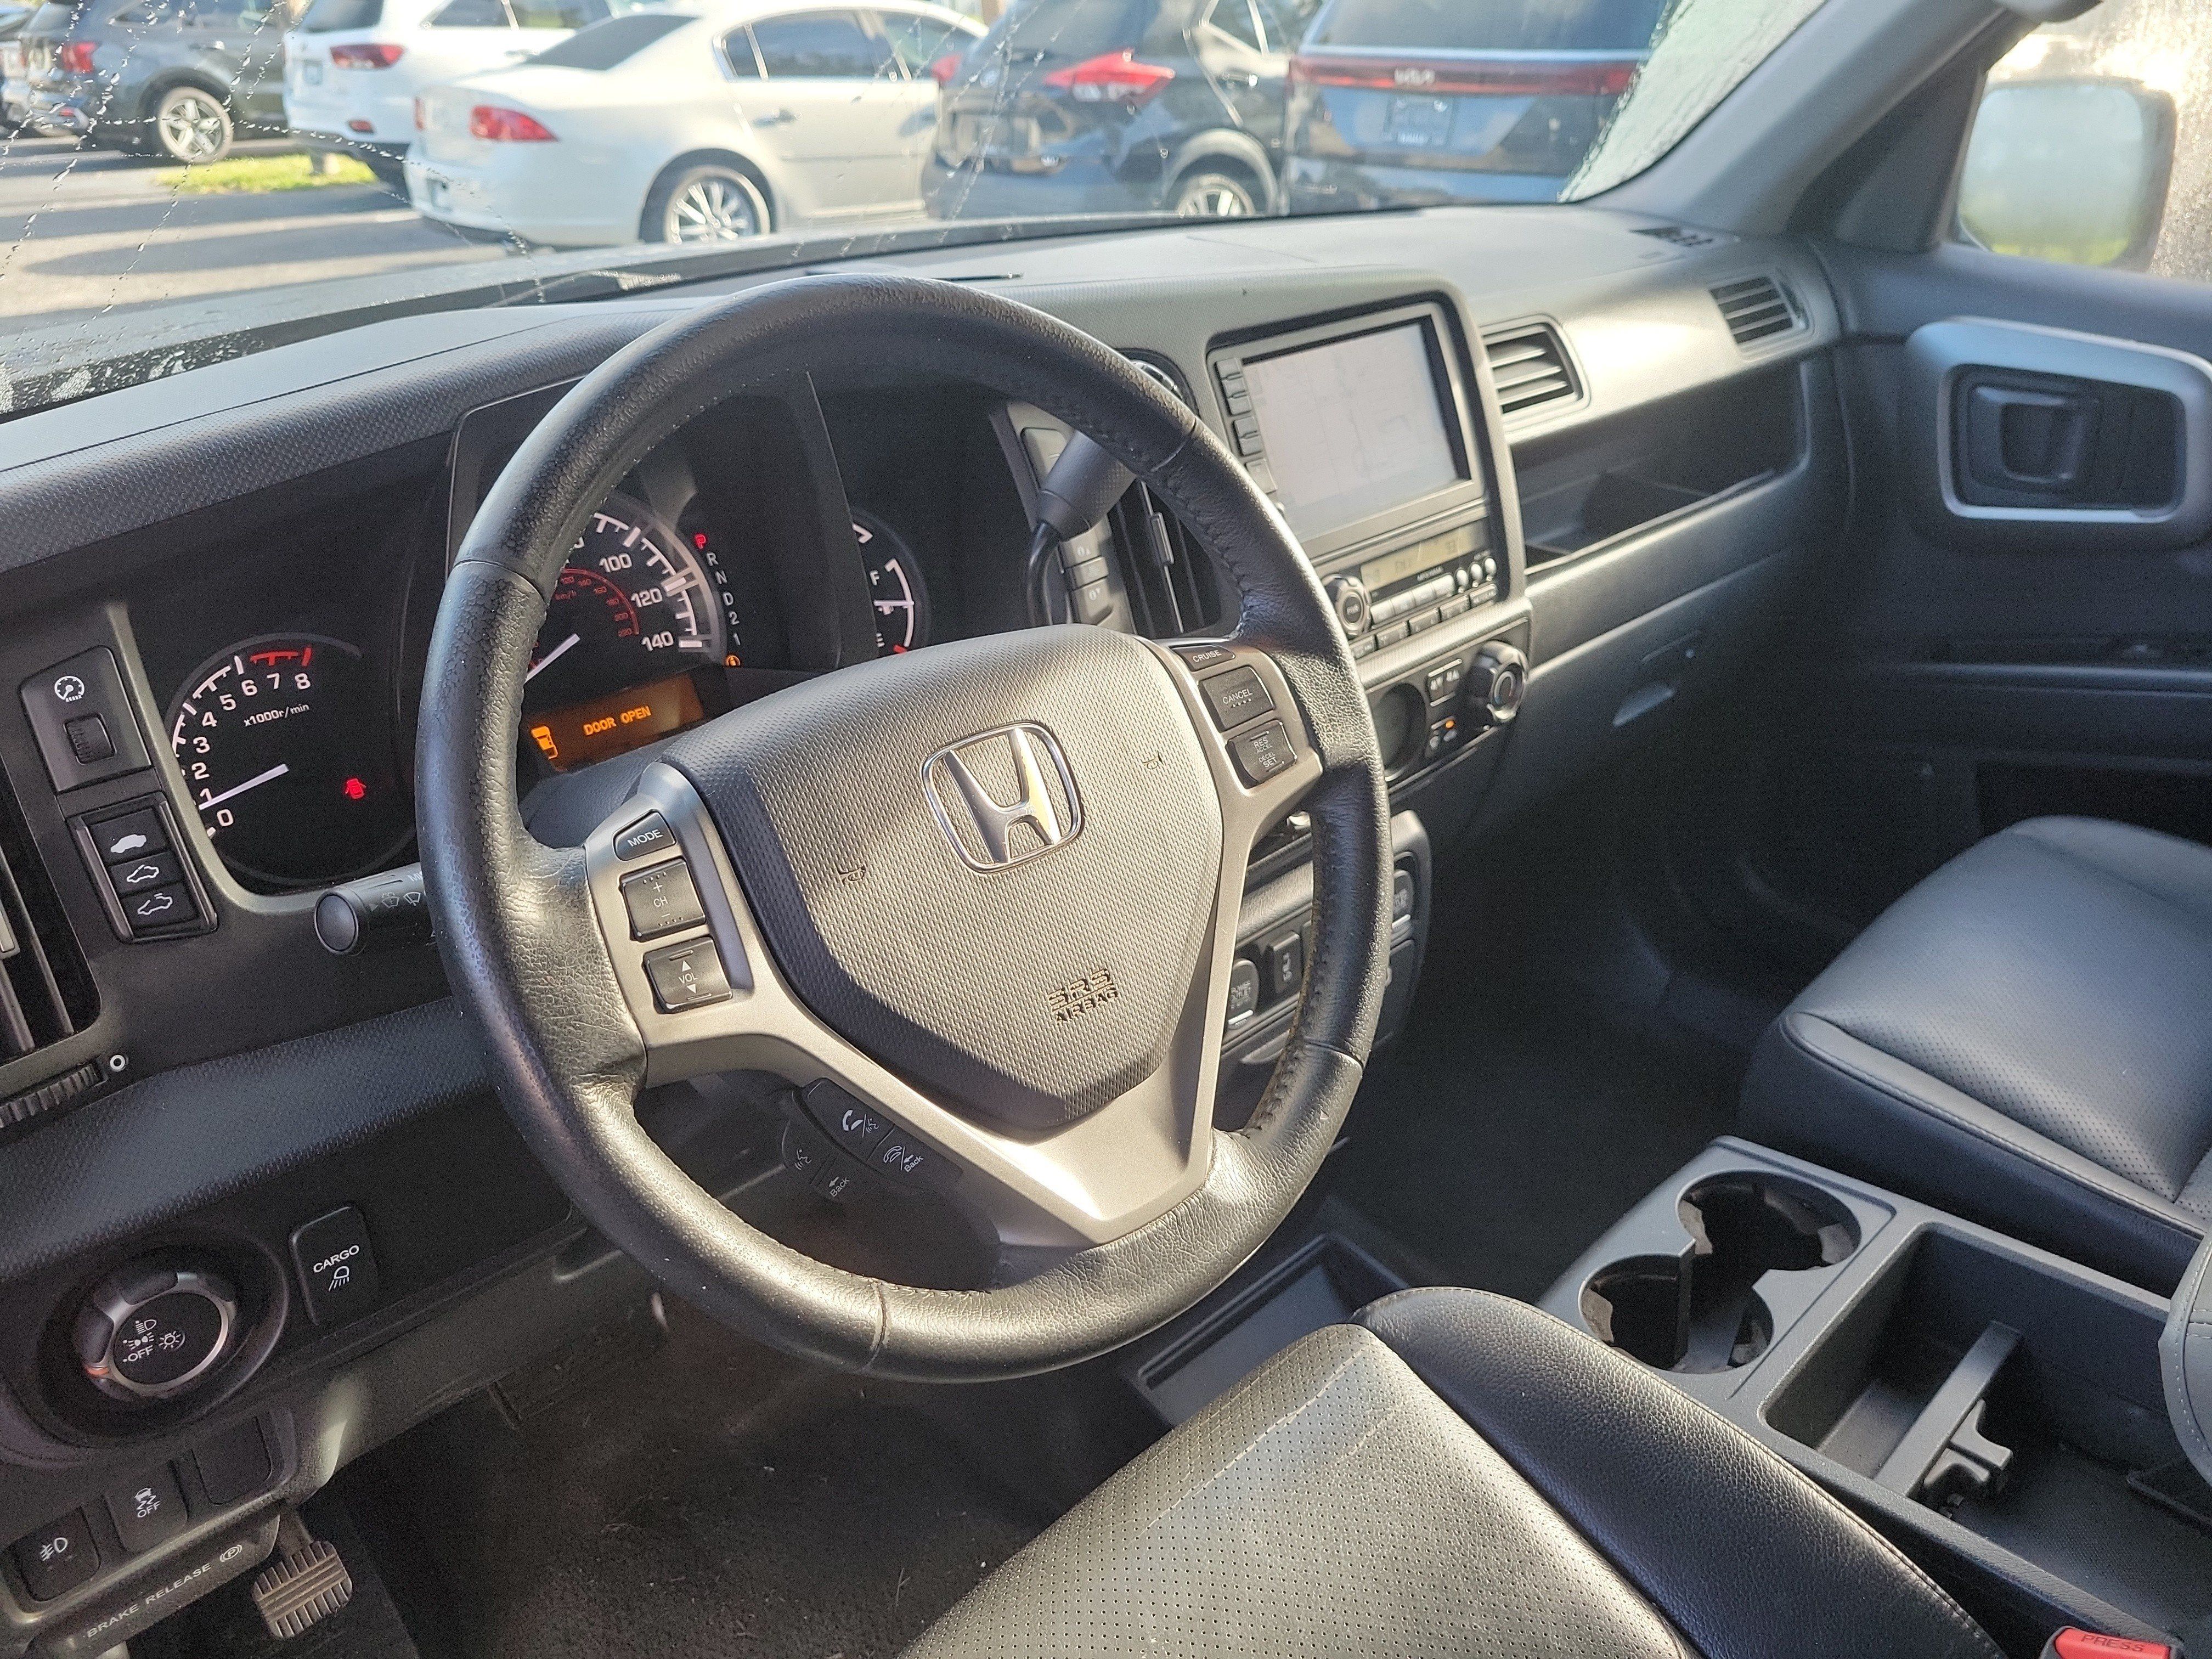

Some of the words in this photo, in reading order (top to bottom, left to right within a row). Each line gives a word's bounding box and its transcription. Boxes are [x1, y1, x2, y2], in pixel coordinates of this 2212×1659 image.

[695, 534, 707, 549] P
[599, 552, 632, 572] 100
[706, 552, 719, 566] R
[715, 571, 728, 584] N
[870, 569, 879, 585] F
[631, 588, 663, 607] 120
[723, 592, 734, 606] D
[729, 612, 740, 625] 2
[641, 631, 674, 651] 140
[733, 633, 741, 646] 1
[1192, 650, 1222, 663] CRUISE
[241, 680, 257, 696] 6
[267, 673, 281, 690] 7
[295, 673, 311, 689] 8
[219, 693, 236, 710] 5
[1222, 688, 1253, 704] CANCEL
[202, 712, 217, 729] 4
[244, 703, 310, 727] x1000r/min
[583, 716, 616, 737] DOOR
[620, 706, 651, 724] OPEN
[193, 736, 210, 753] 3
[1253, 737, 1268, 748] RES
[1262, 757, 1277, 768] SET
[192, 763, 210, 780] 2
[200, 788, 213, 803] 1
[217, 809, 234, 827] 0
[627, 829, 663, 847] MODE
[653, 897, 668, 907] CH
[678, 972, 698, 984] VOL
[1048, 969, 1113, 1011] SRS
[1056, 986, 1118, 1025] AIRBAG
[903, 1154, 924, 1172] Back
[830, 1177, 850, 1197] Back
[313, 1245, 359, 1273] CARGO
[128, 1345, 154, 1363] OFF
[137, 1502, 160, 1518] OFF
[86, 1604, 139, 1638] BRAKE
[145, 1564, 212, 1605] RELEASE
[2081, 1634, 2143, 1652] PRESS
